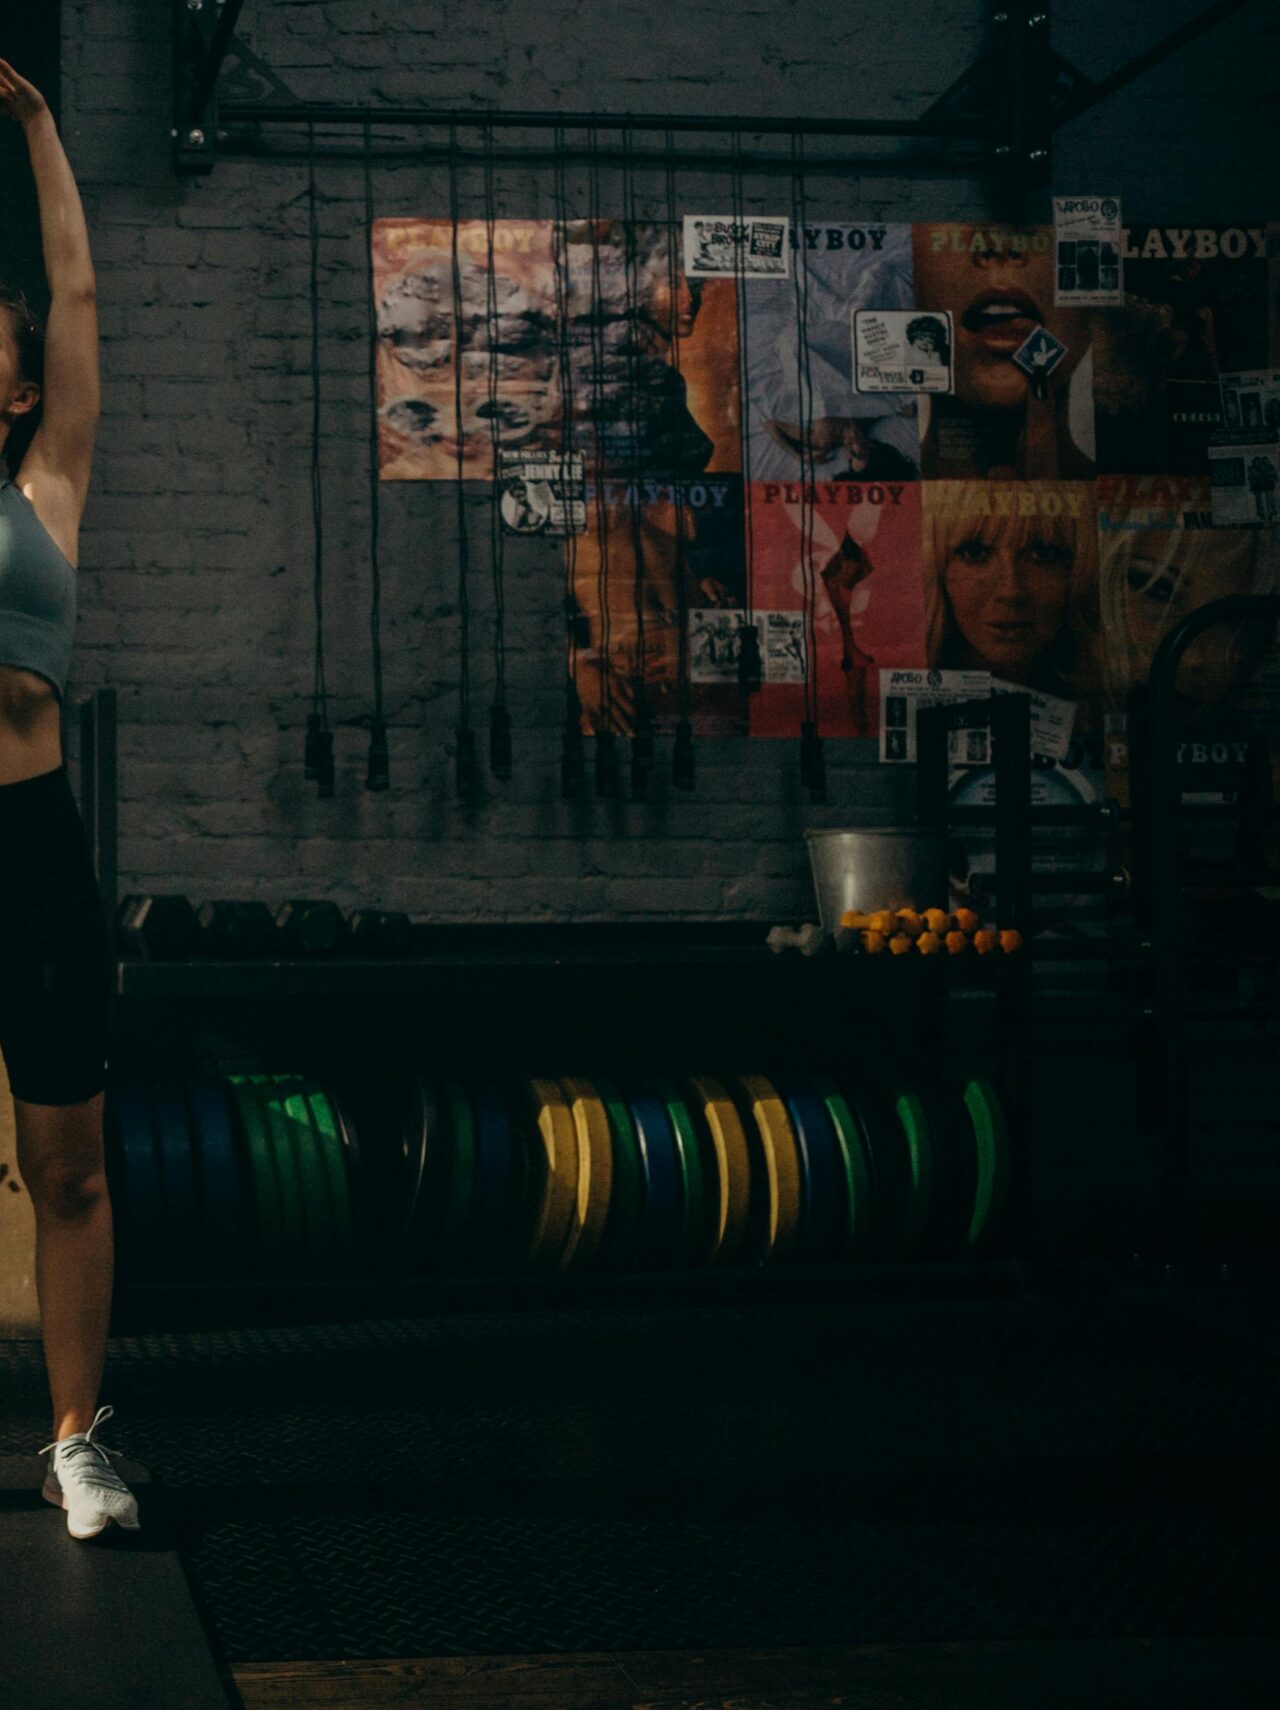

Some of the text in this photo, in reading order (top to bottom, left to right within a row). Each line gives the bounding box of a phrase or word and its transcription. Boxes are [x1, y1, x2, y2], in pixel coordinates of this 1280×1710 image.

[789, 229, 887, 249] AYBOY
[930, 231, 1052, 252] PLAYBO
[1121, 227, 1267, 259] LAYBOY
[763, 484, 905, 505] PLAYBOY
[936, 489, 1081, 517] AYBOY
